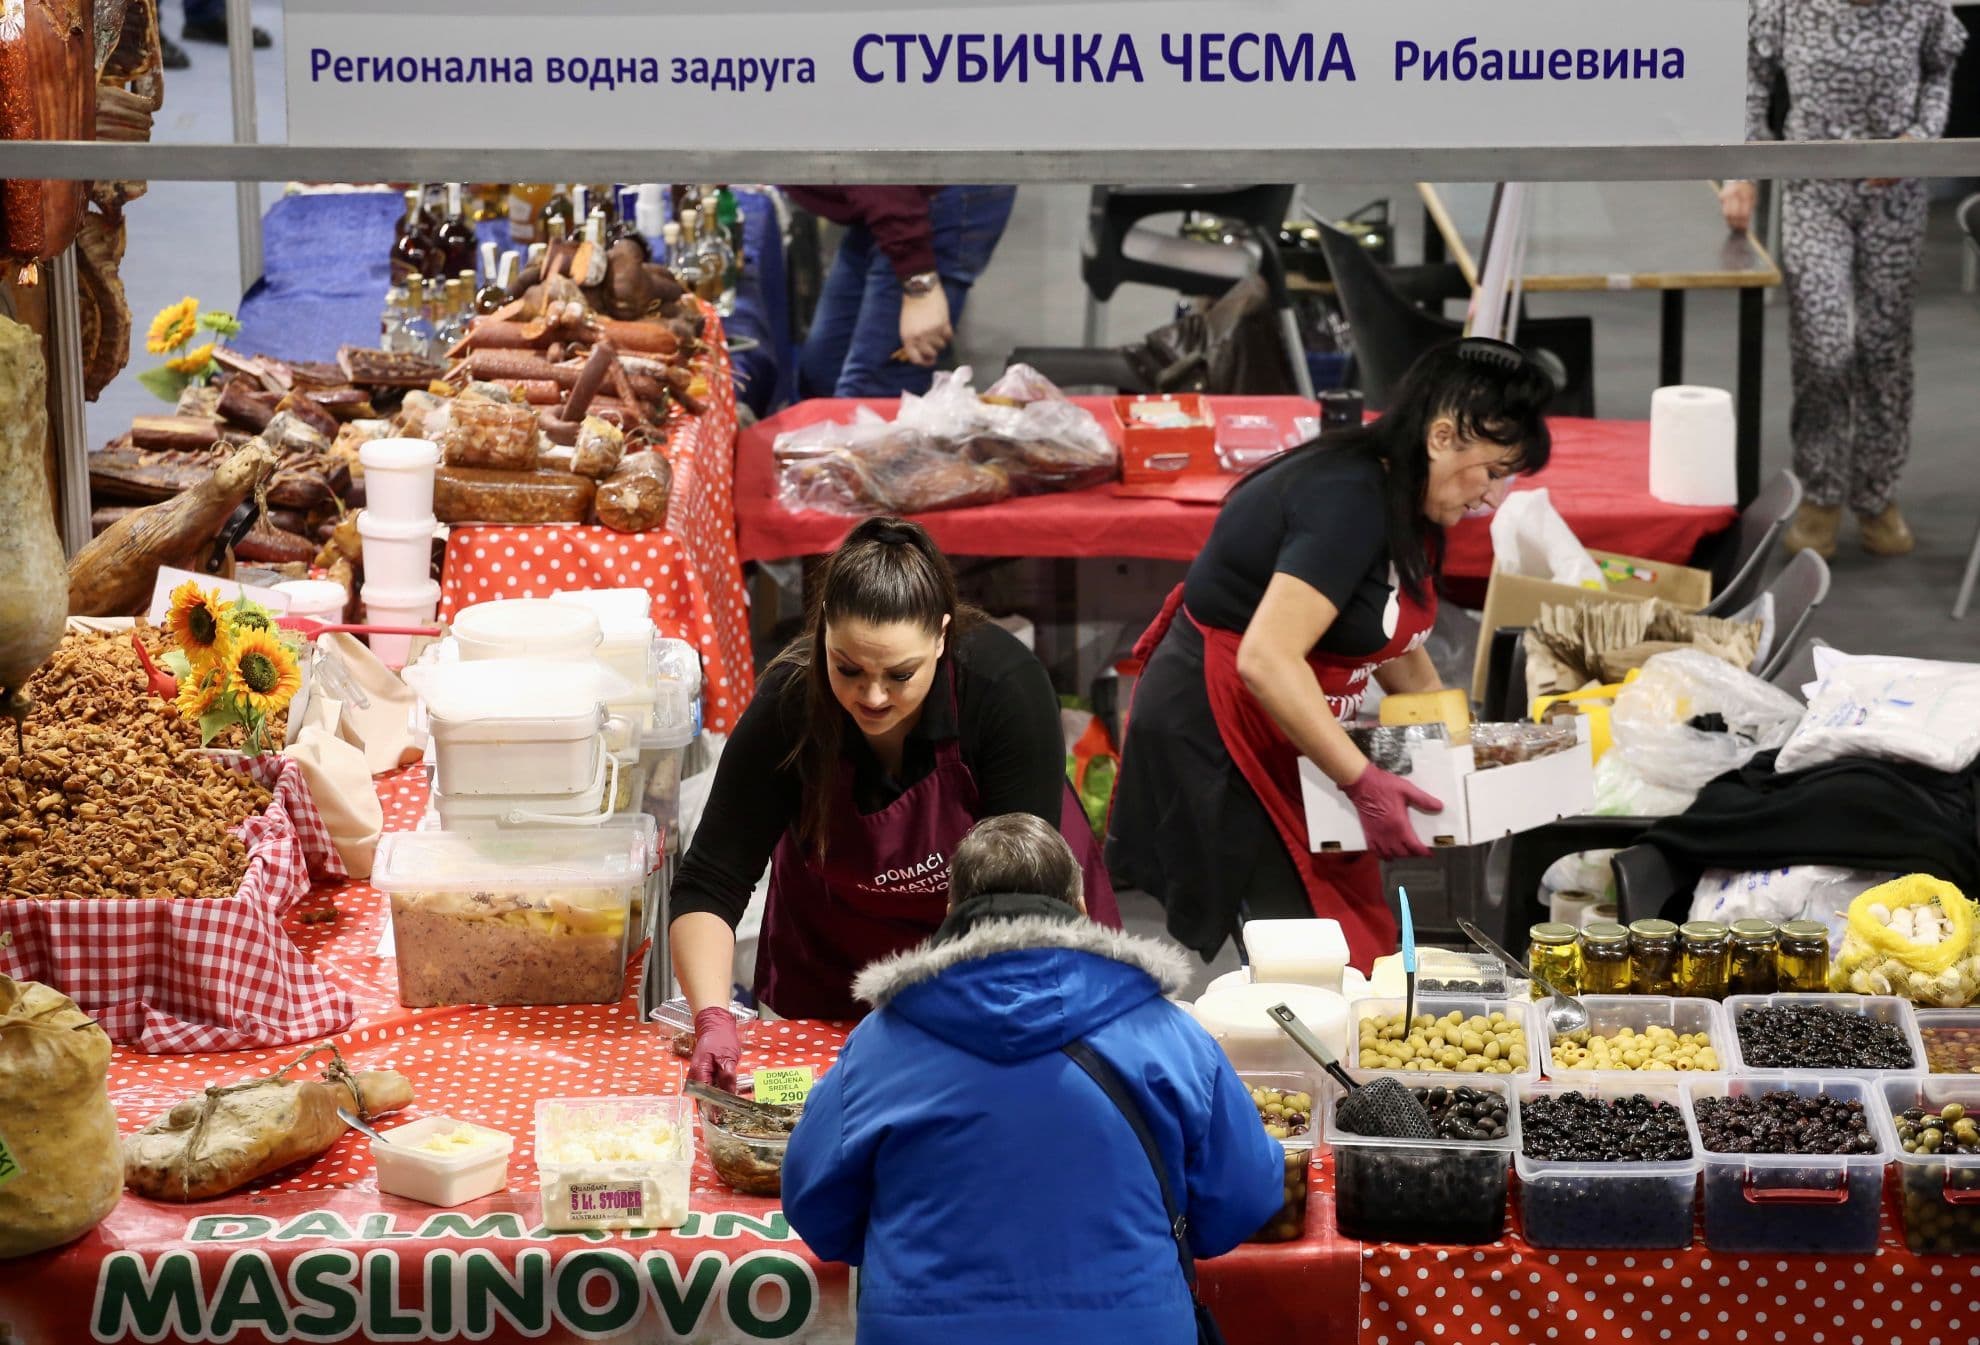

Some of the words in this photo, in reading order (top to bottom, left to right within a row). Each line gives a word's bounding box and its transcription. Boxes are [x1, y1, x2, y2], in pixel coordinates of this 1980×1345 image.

[310, 47, 533, 84] Регионална
[546, 56, 659, 91] водна
[671, 57, 816, 92] задруга
[852, 33, 1145, 84] СТУБИЧКА
[1160, 32, 1357, 83] ЧЕСМА
[1394, 36, 1685, 81] Рибашевина
[874, 852, 944, 886] DOMAĆI
[780, 1091, 804, 1102] 290
[571, 1193, 579, 1210] 5
[97, 1251, 813, 1340] MASLINOVO
